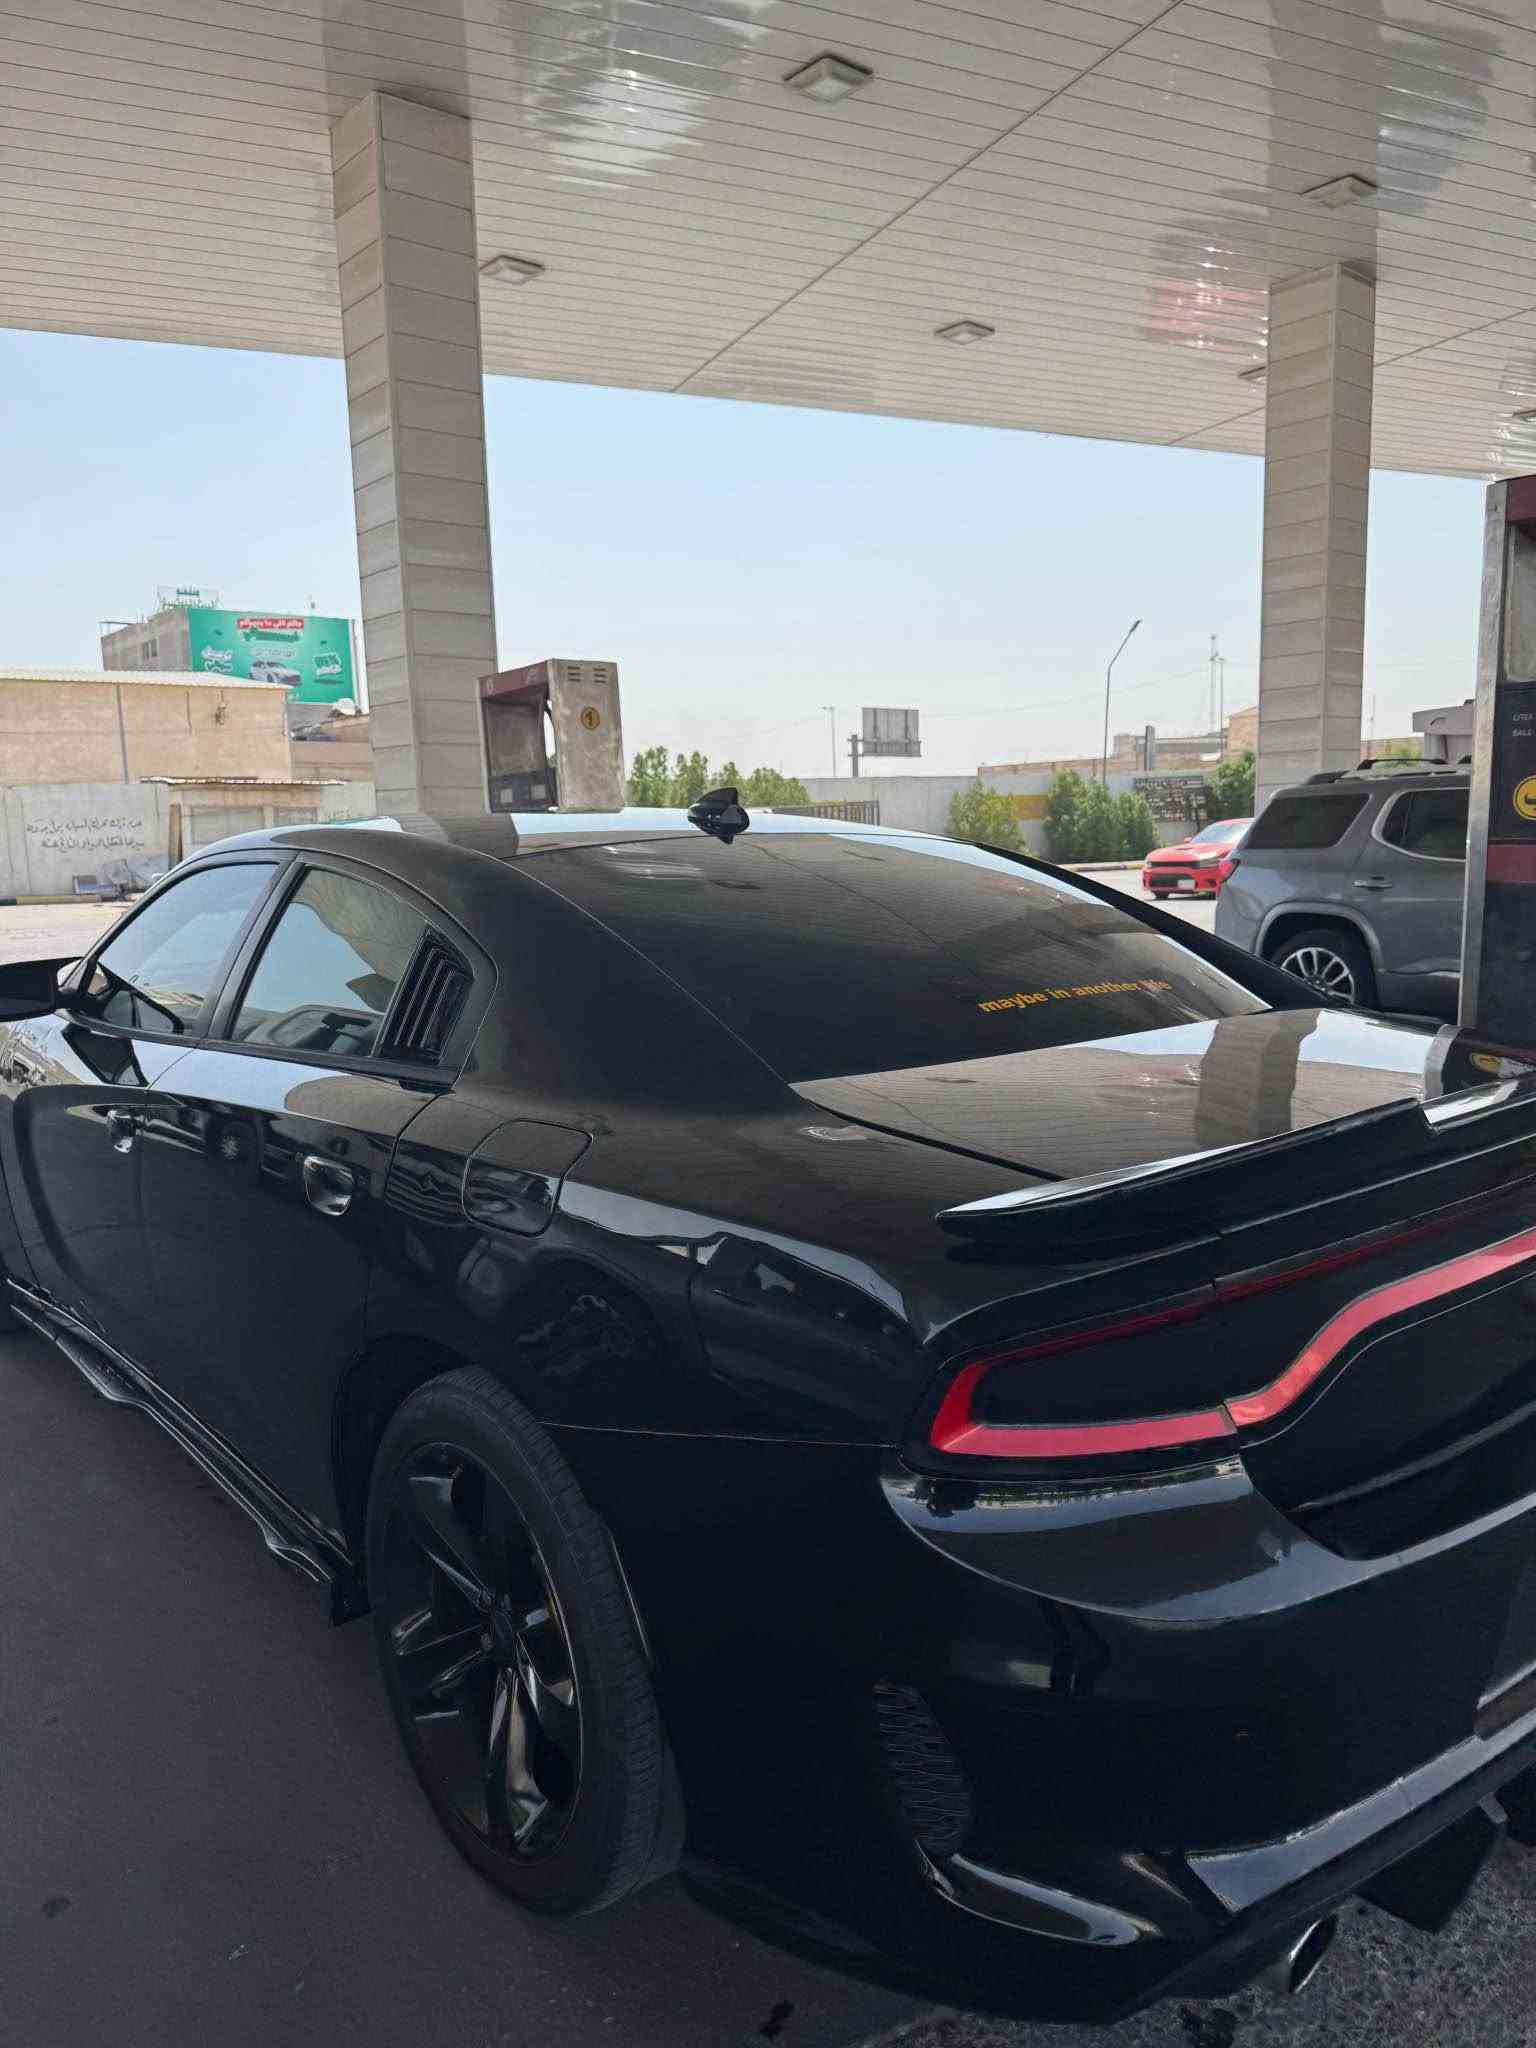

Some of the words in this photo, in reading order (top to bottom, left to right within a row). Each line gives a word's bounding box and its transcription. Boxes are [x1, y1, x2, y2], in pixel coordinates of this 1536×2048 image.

[977, 992, 1049, 1012] maybe
[1045, 988, 1071, 1000] in
[1072, 981, 1137, 997] another
